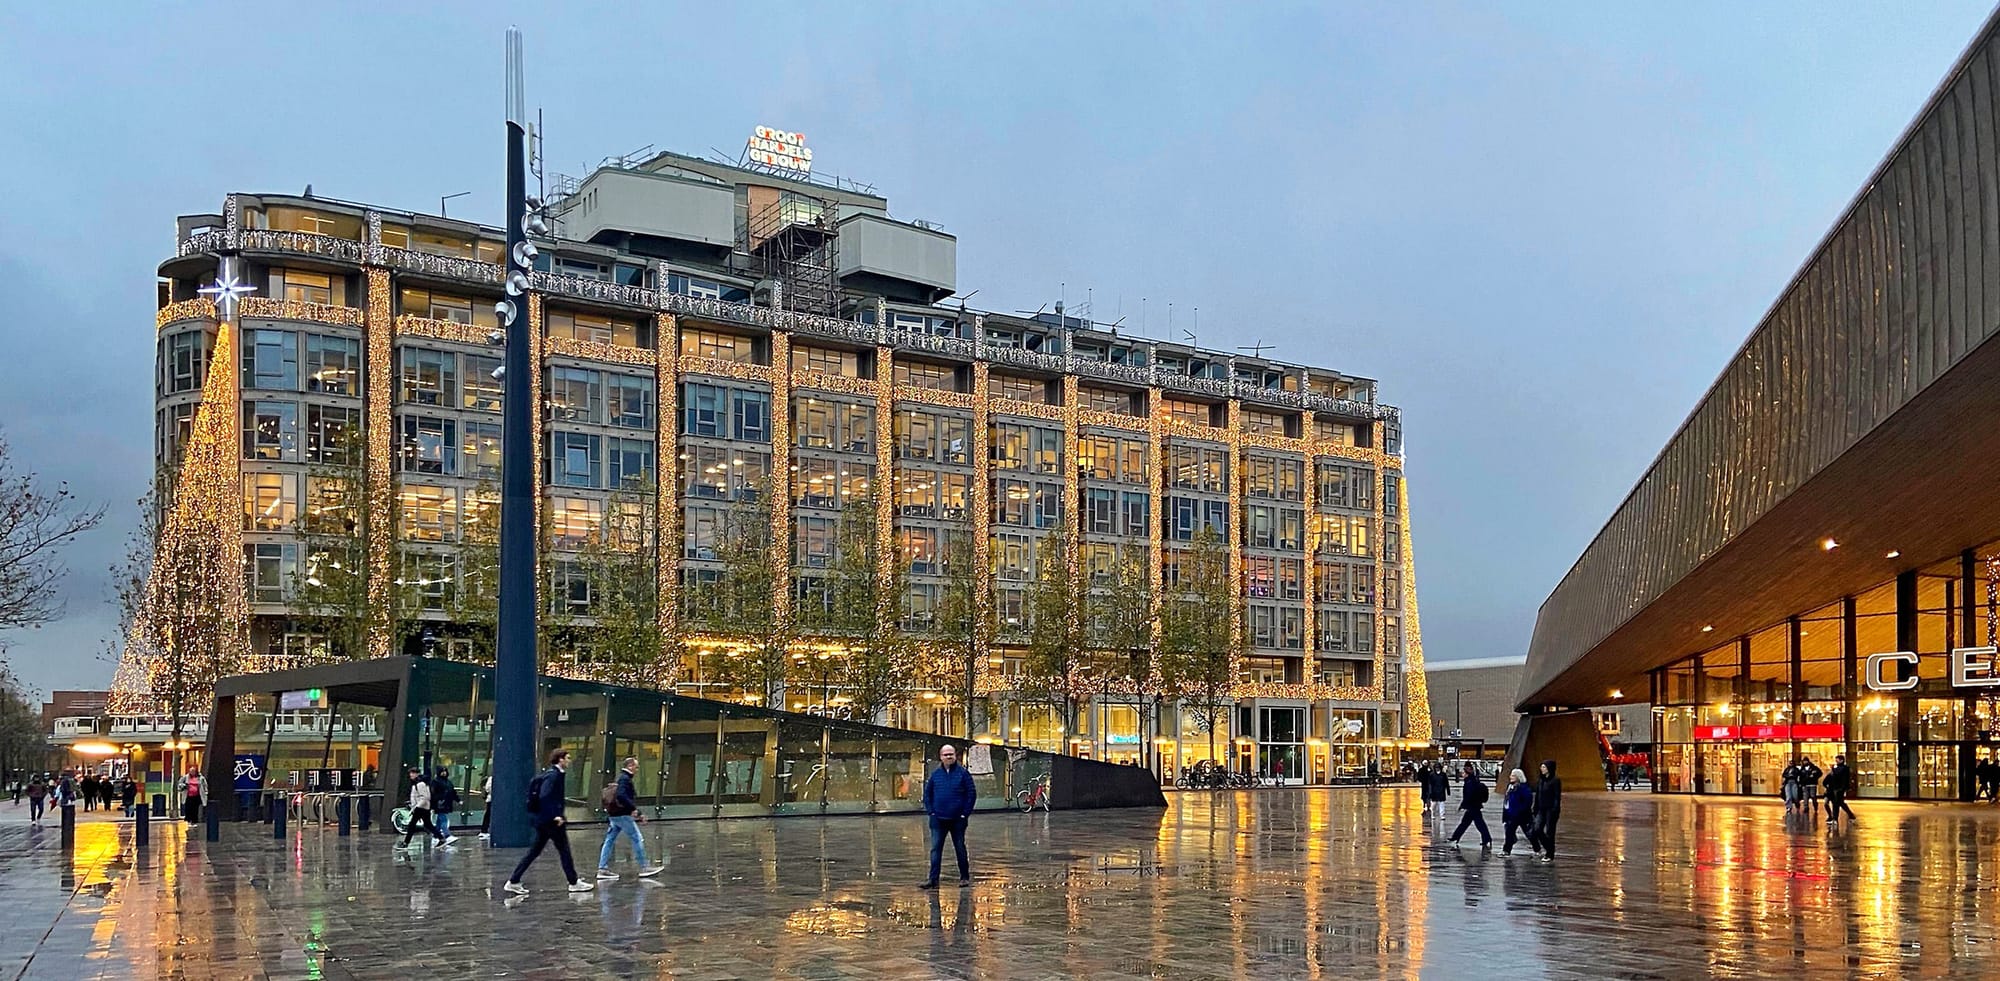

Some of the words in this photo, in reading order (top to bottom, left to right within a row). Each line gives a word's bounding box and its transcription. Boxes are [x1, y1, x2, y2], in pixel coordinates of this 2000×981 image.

[749, 136, 812, 160] HANDELS
[755, 125, 805, 147] GROOT
[749, 148, 811, 172] GEBOUW
[1866, 646, 2000, 690] CE
